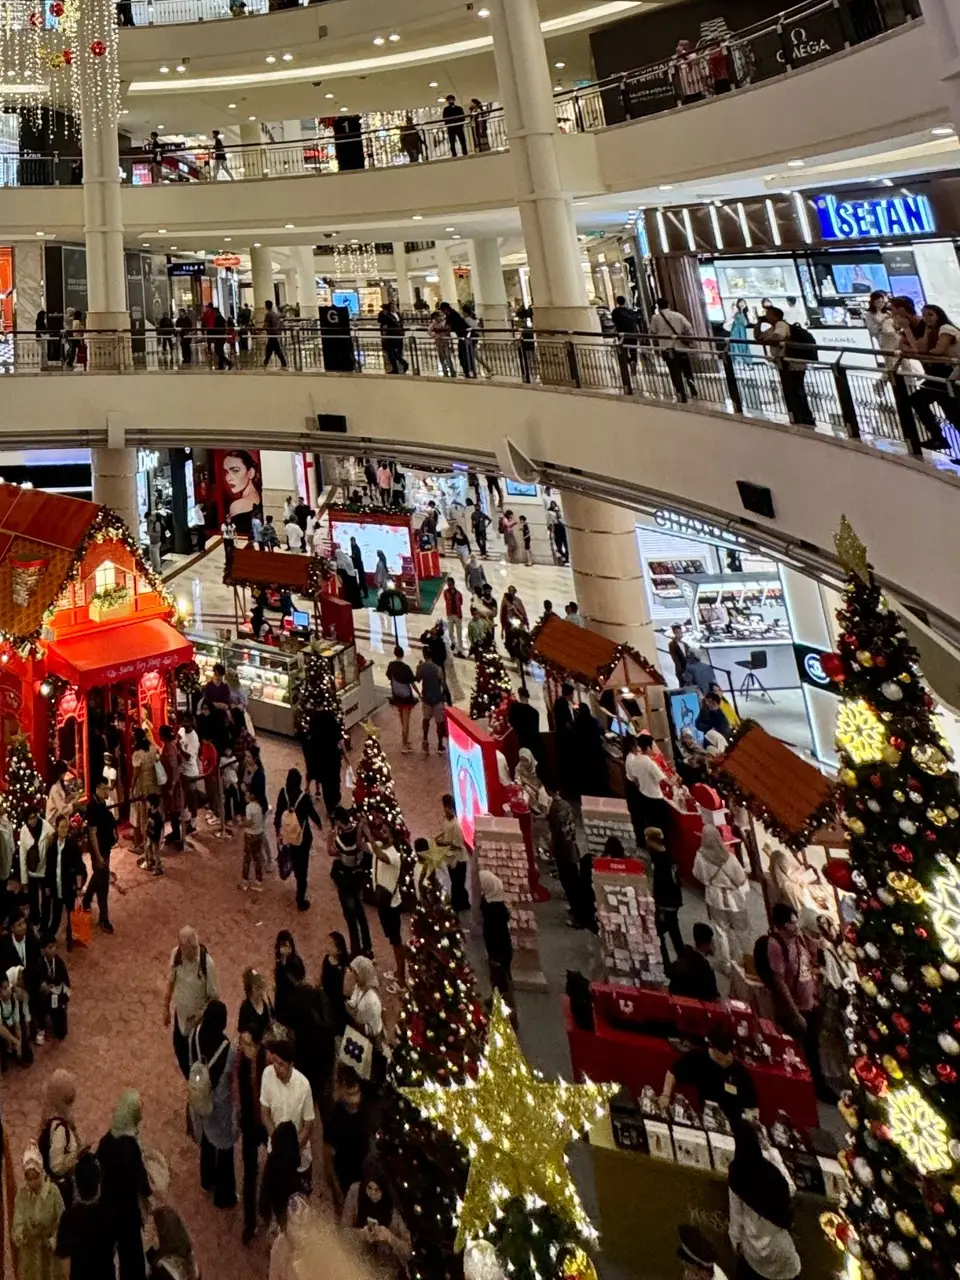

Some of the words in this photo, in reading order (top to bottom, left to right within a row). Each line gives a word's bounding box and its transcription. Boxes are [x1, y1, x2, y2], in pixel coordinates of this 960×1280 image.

[342, 120, 349, 133] 1
[326, 309, 339, 324] G
[822, 336, 857, 344] CHANEL
[138, 448, 160, 472] Dior
